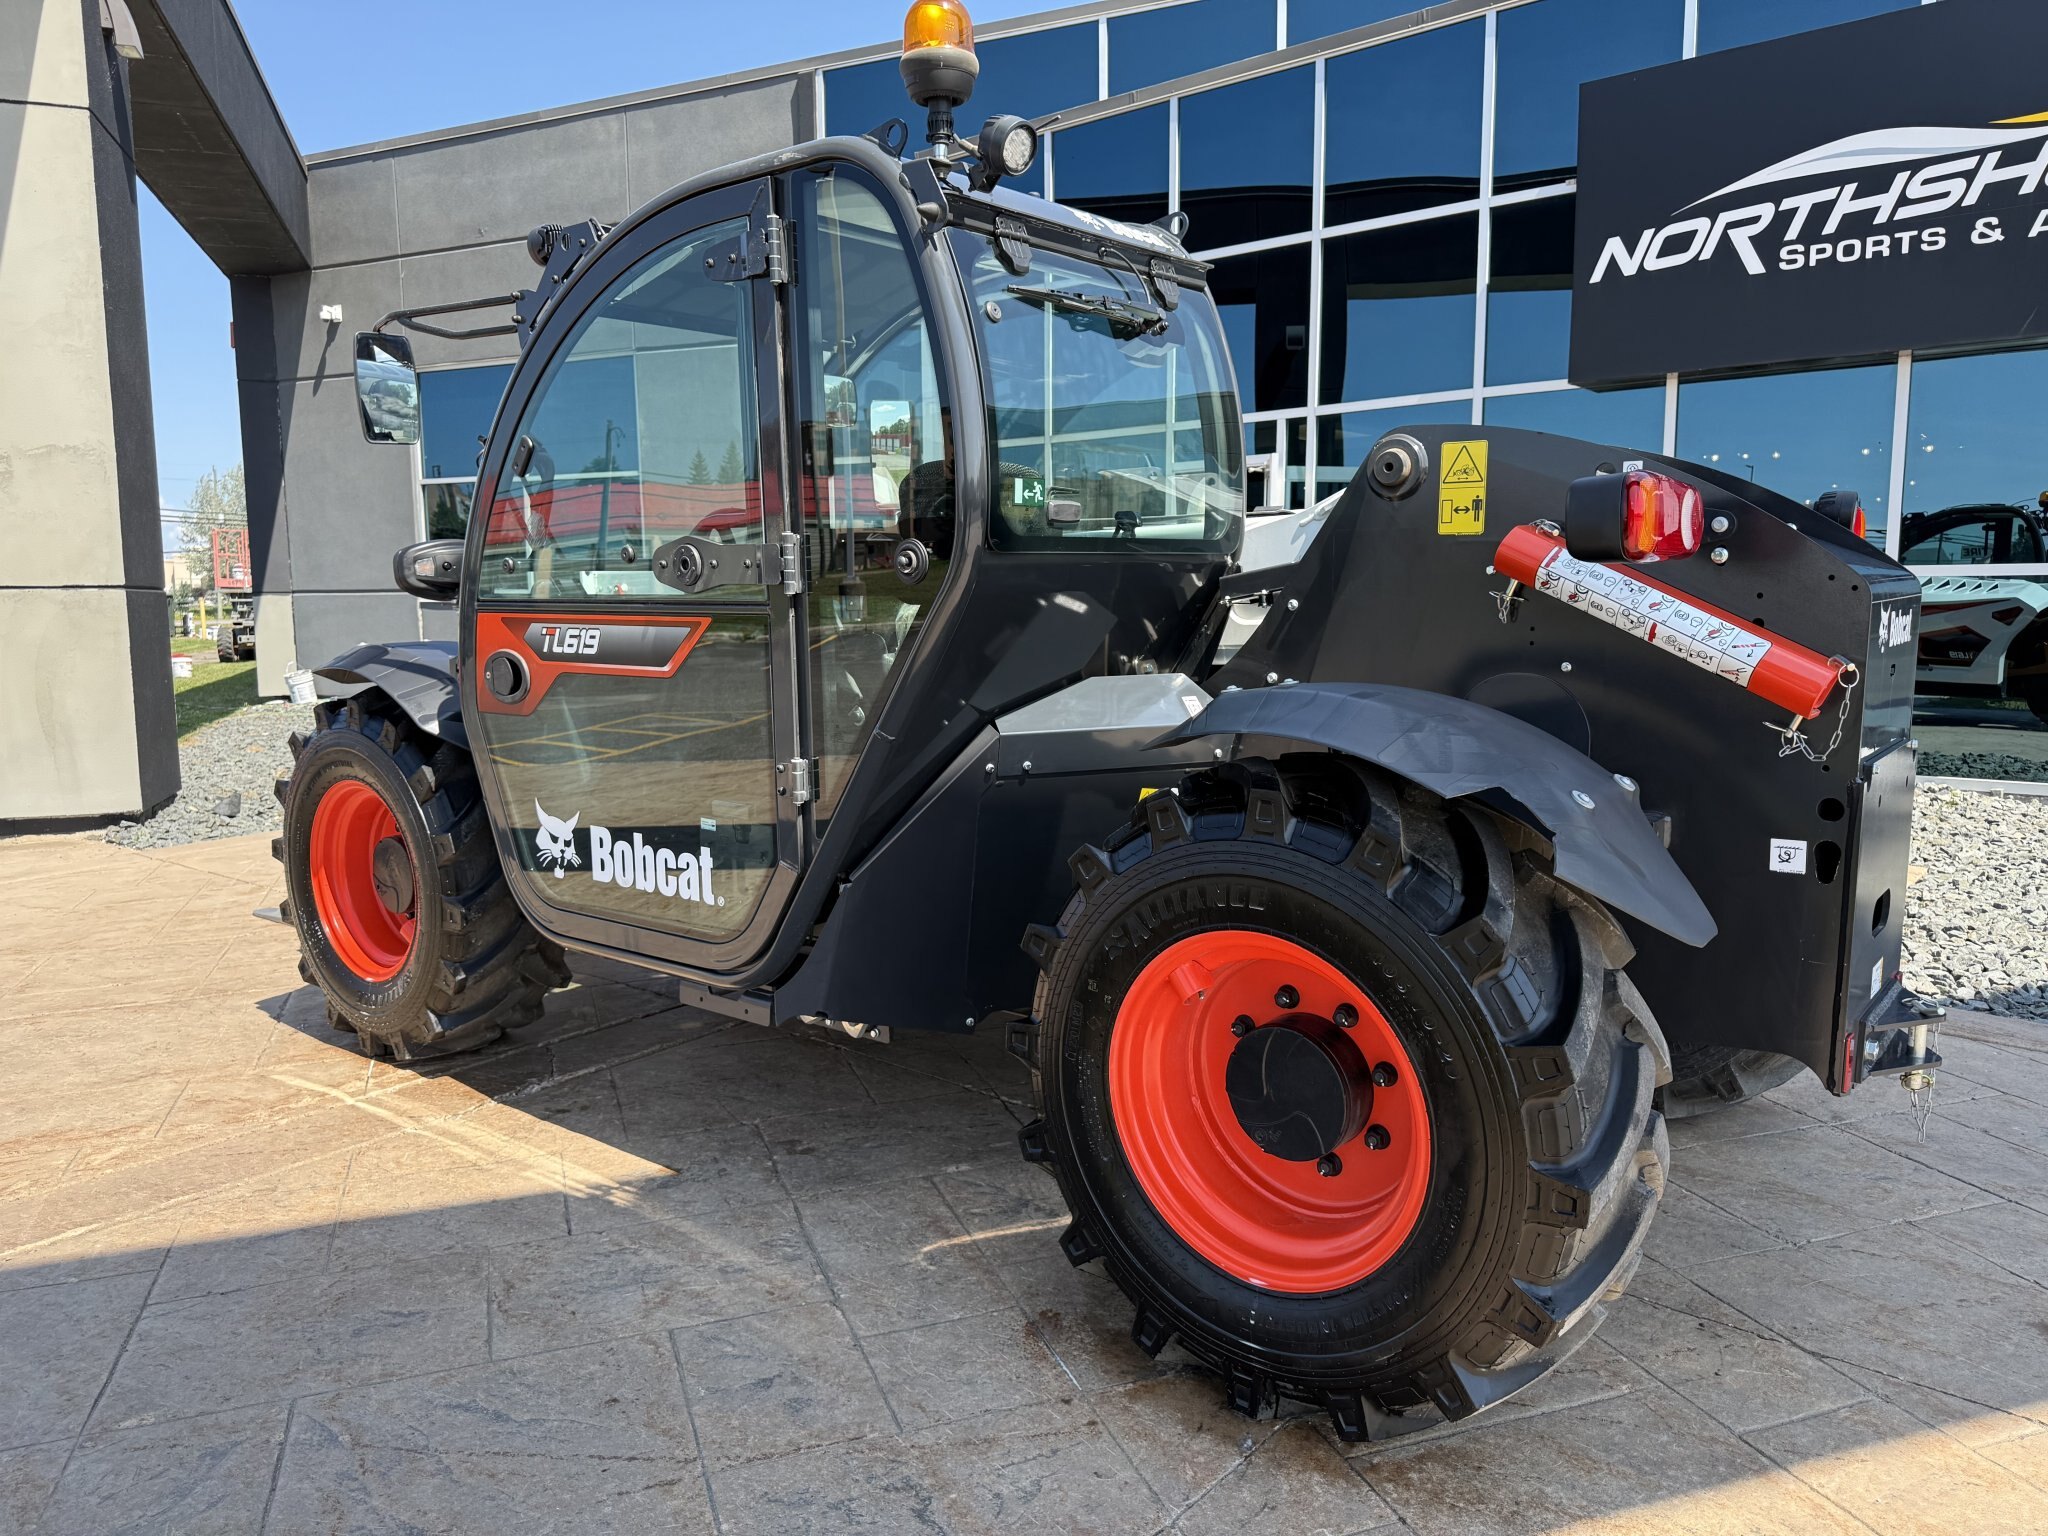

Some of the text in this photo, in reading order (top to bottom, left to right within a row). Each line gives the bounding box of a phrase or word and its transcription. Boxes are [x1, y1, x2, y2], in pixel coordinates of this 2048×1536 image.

[1589, 140, 2048, 283] NORTHSH
[1779, 227, 1946, 271] SPORTS
[1971, 216, 2005, 244] &
[541, 626, 600, 654] TL619
[590, 825, 716, 906] Bobcat
